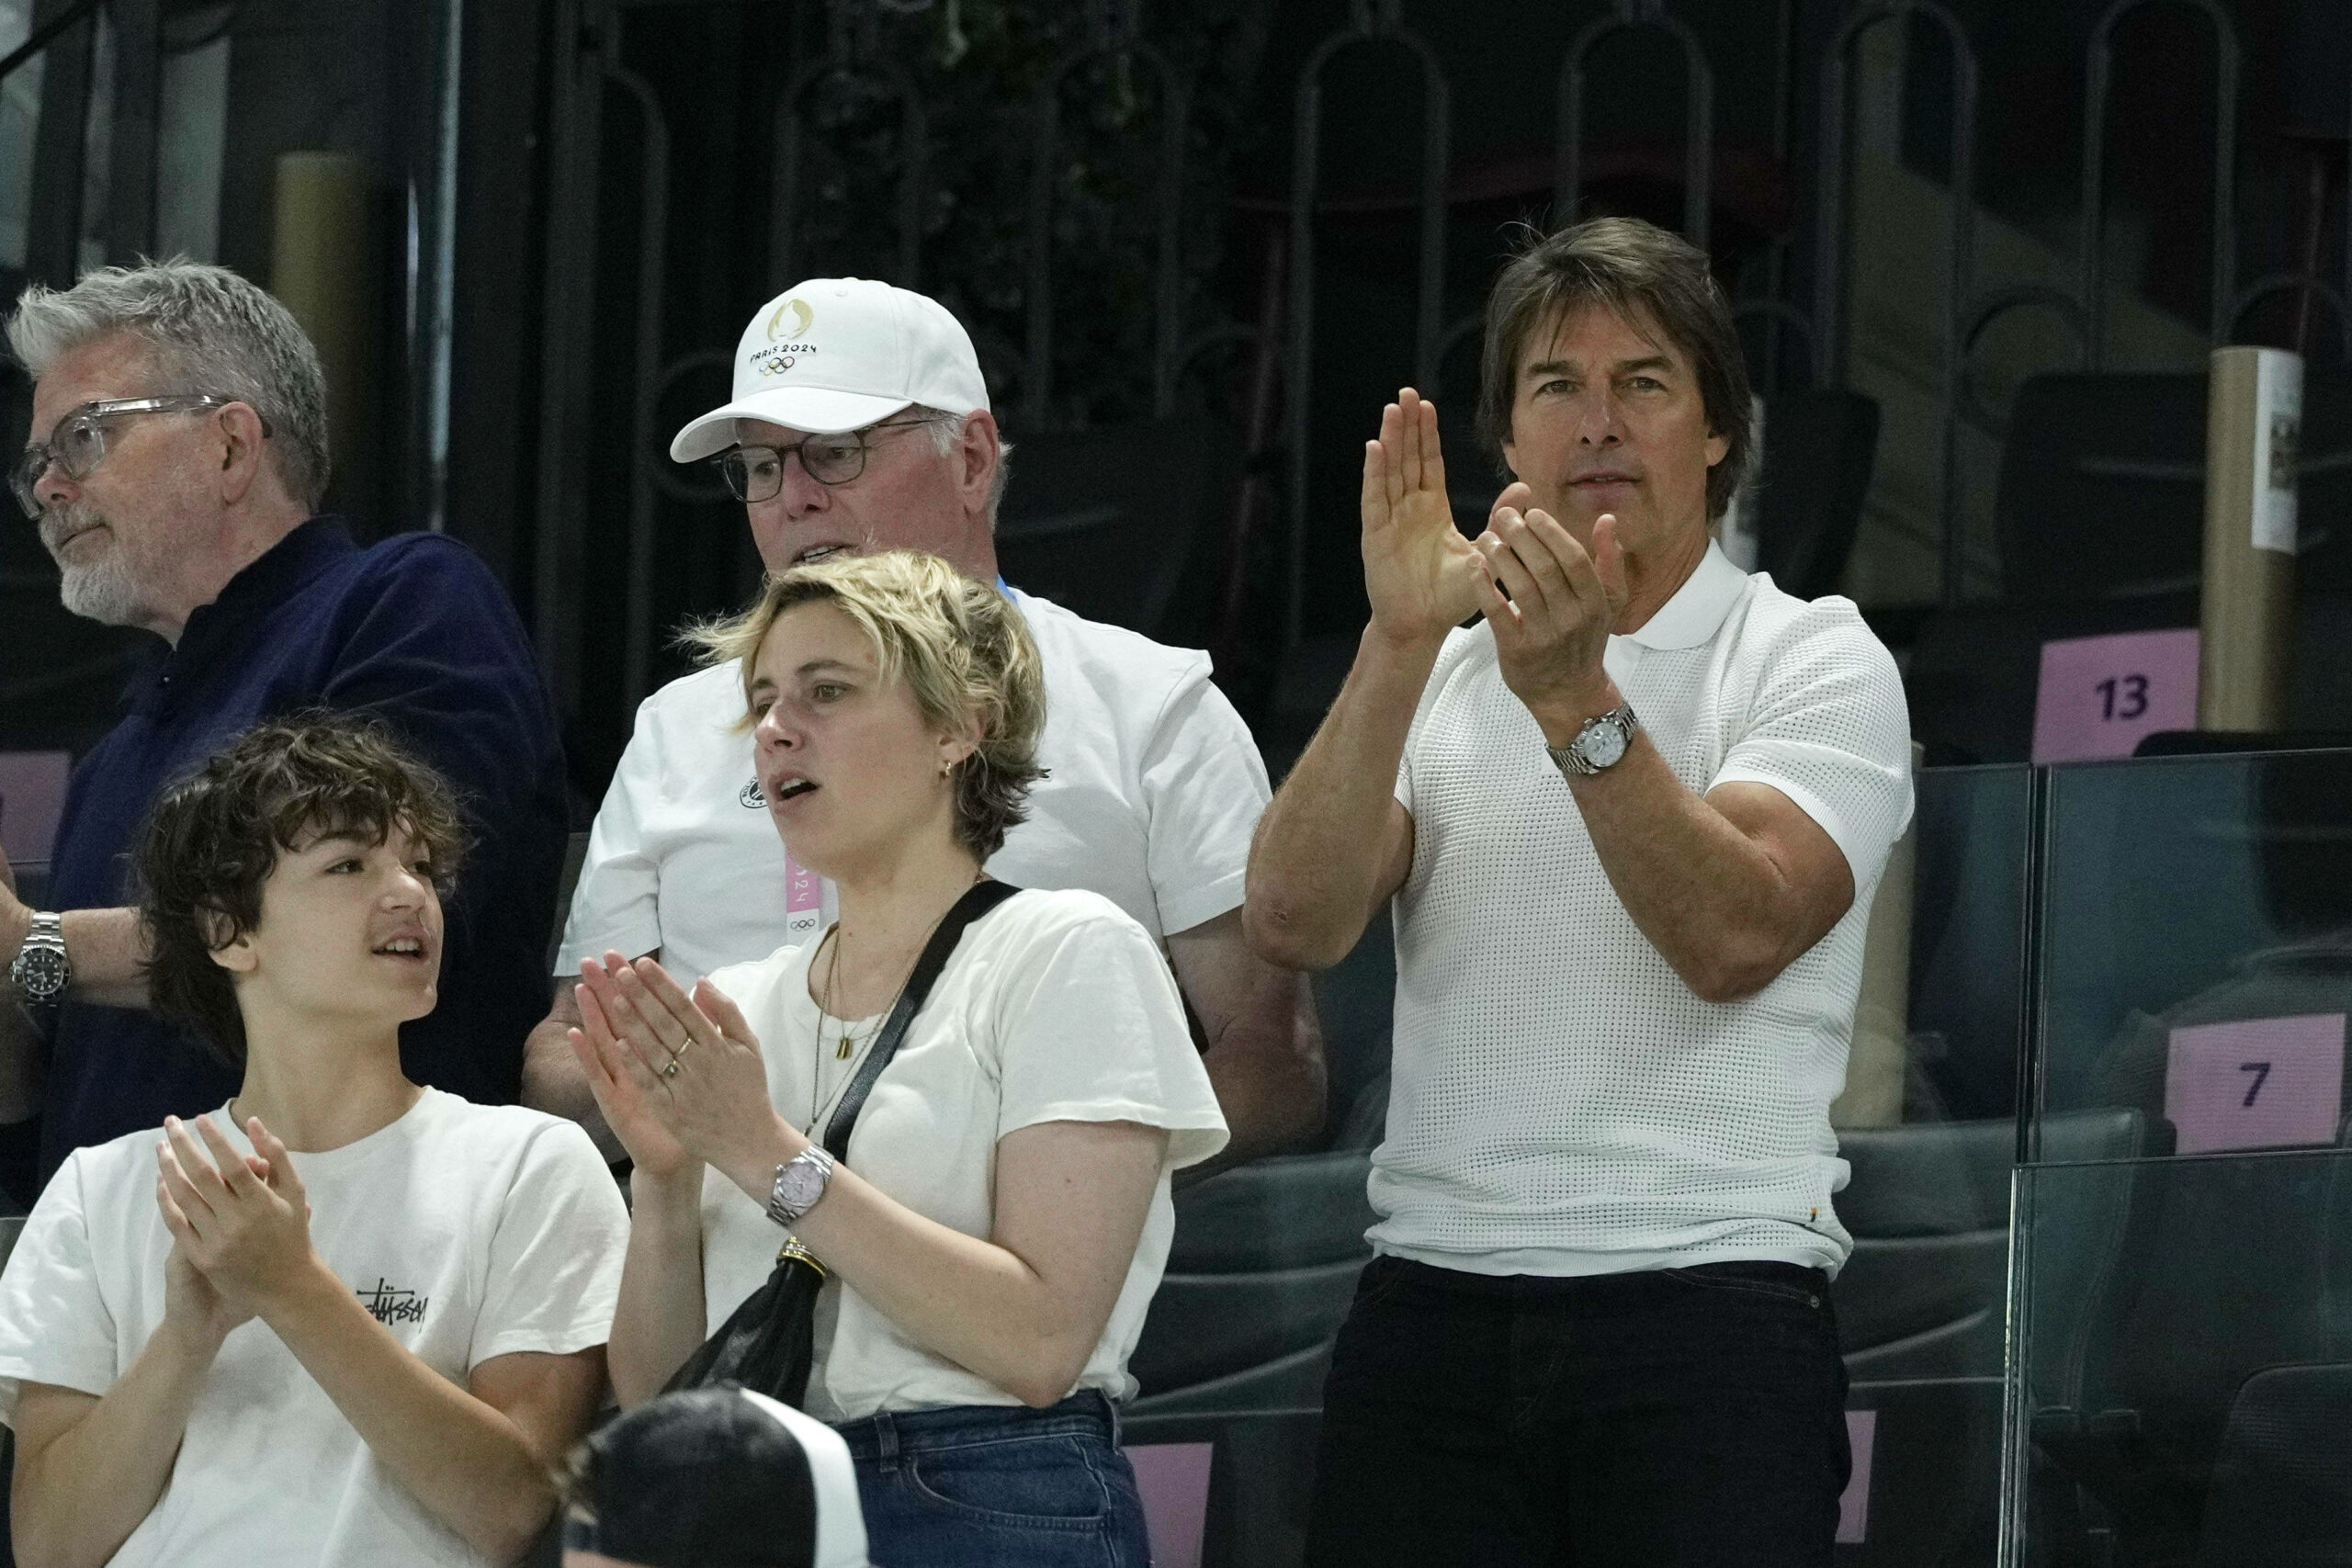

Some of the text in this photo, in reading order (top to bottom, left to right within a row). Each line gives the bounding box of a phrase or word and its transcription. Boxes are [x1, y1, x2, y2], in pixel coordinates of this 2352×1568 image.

[781, 344, 817, 354] 2024
[2096, 674, 2148, 721] 13
[2240, 1062, 2270, 1107] 7
